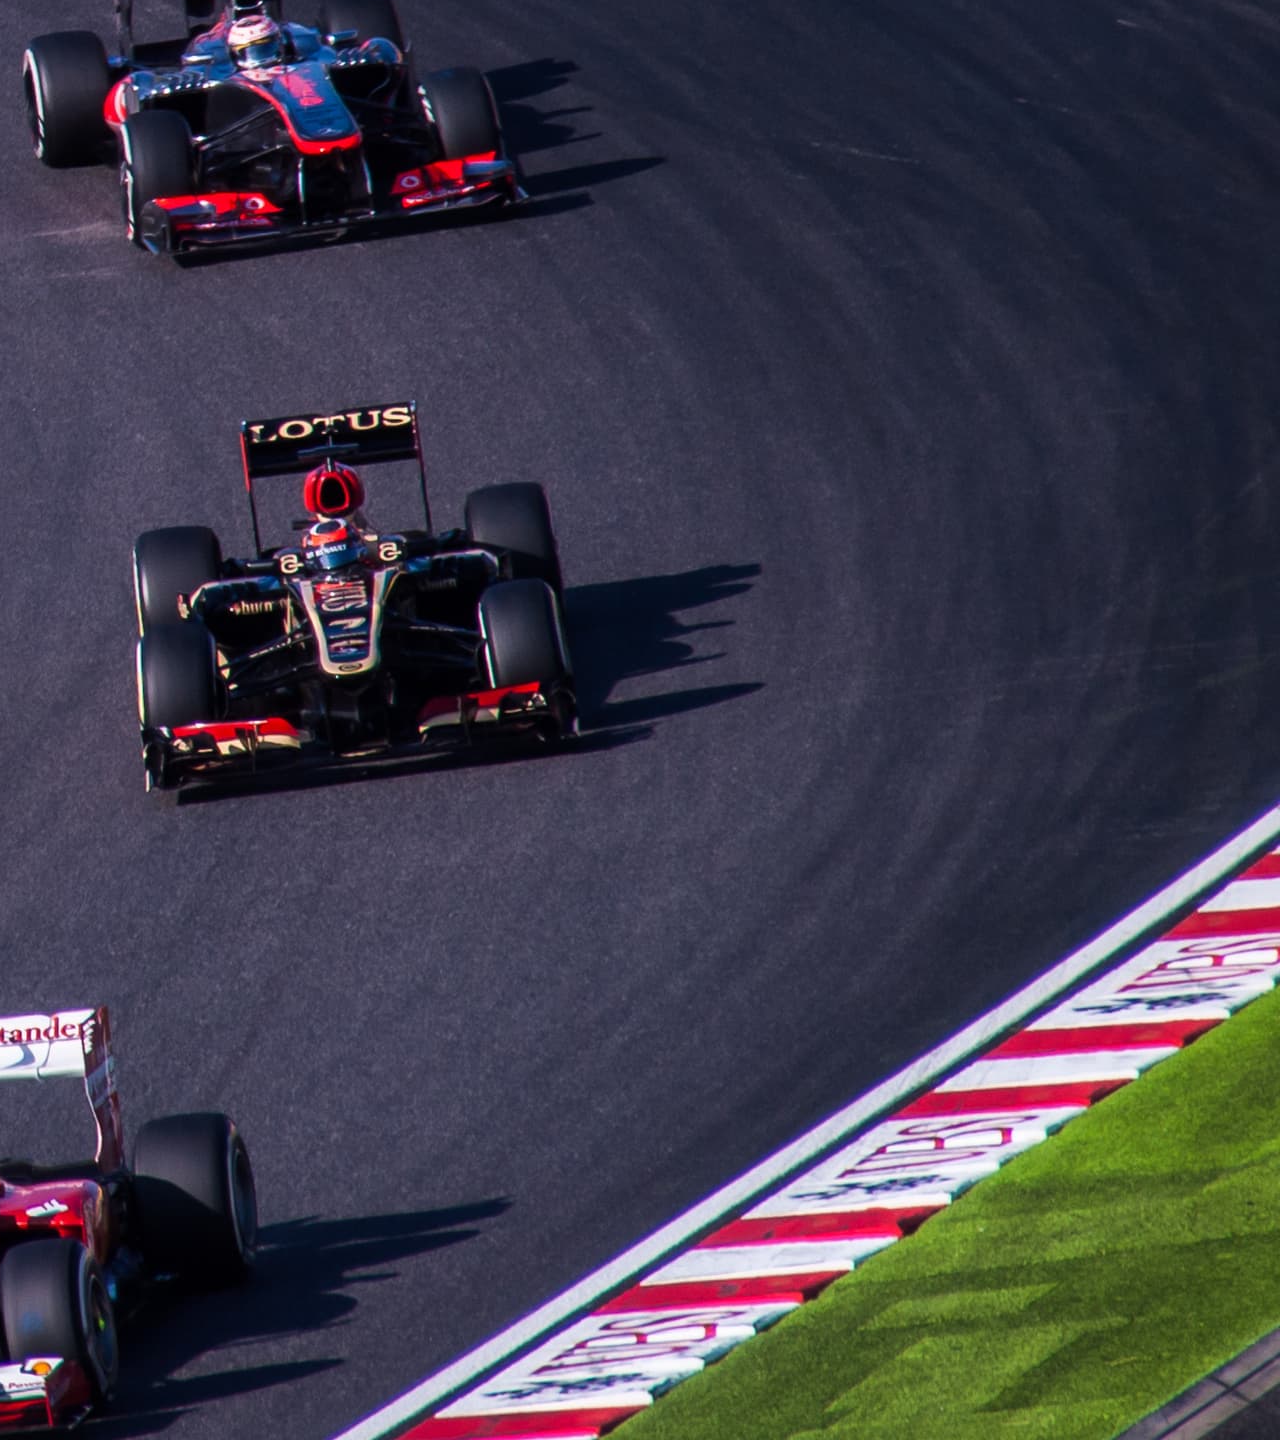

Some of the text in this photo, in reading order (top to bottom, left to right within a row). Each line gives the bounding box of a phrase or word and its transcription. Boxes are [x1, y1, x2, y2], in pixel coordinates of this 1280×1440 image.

[248, 407, 412, 443] LOTUS
[837, 1114, 1039, 1180] UBS
[531, 1310, 748, 1377] UBS
